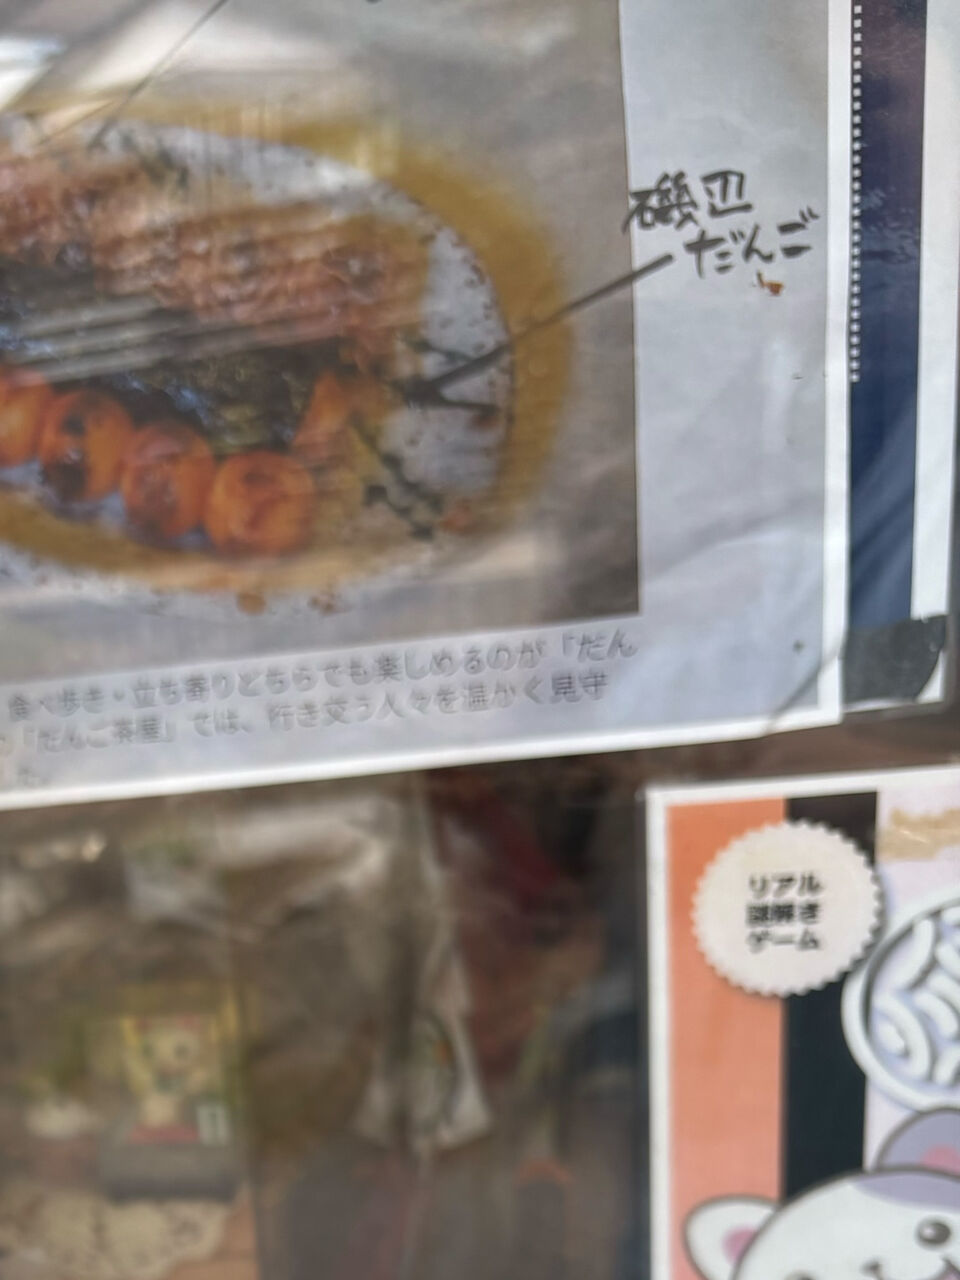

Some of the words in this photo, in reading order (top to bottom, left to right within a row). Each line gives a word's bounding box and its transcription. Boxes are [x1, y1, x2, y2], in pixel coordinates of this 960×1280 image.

[683, 206, 821, 279] だんご
[749, 872, 824, 899] リアル
[745, 930, 820, 954] ゲーム
